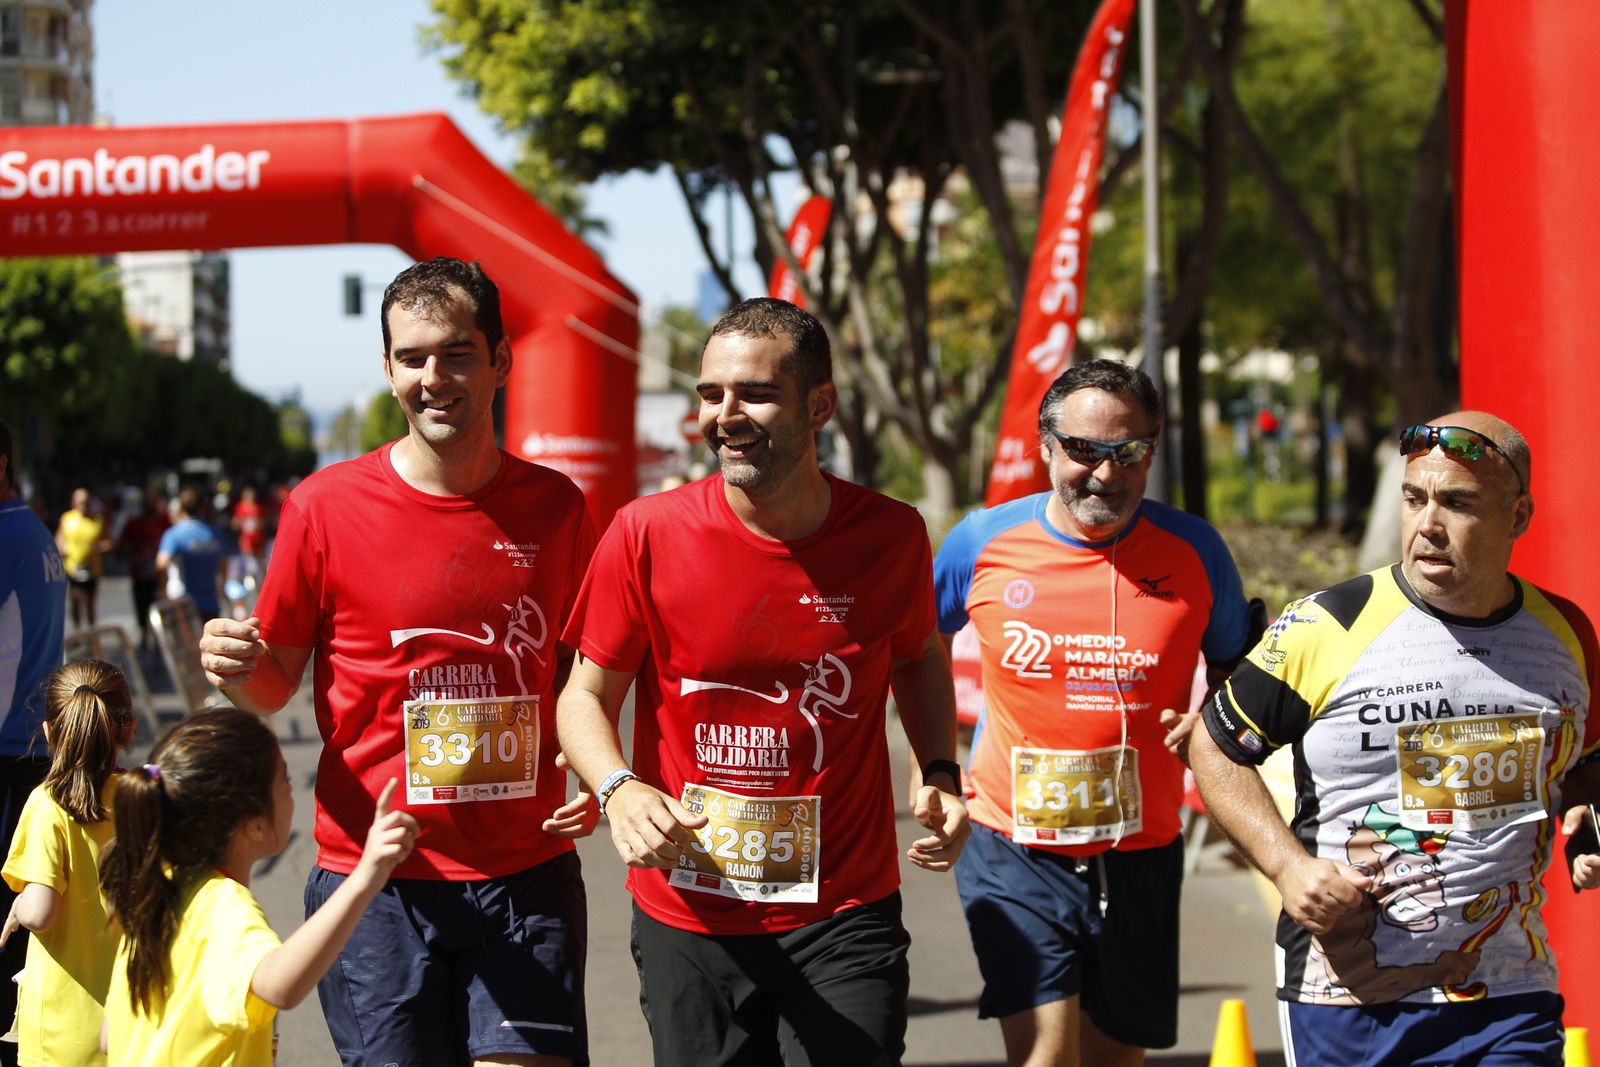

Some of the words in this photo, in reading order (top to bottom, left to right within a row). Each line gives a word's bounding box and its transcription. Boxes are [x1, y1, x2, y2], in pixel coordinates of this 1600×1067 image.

[0, 144, 270, 199] Santander
[504, 542, 540, 550] Santander
[813, 594, 855, 604] Santander
[1065, 634, 1126, 648] MEDIO
[1065, 649, 1159, 666] MARATÓN
[409, 664, 497, 686] CARRERA
[1065, 666, 1147, 682] ALMERÍA
[409, 685, 498, 700] SOLIDARIA
[1358, 690, 1371, 699] IV
[1376, 682, 1444, 697] CARRERA
[437, 705, 450, 726] 6
[457, 704, 503, 715] CARRERA
[458, 712, 504, 723] SOLIDARIA
[1358, 698, 1454, 725] CUNA
[1466, 704, 1488, 715] DE
[1495, 704, 1514, 714] LA
[412, 719, 430, 730] 2019
[694, 723, 790, 748] CARRERA
[1430, 725, 1444, 748] 6
[1452, 722, 1500, 734] CARRERA
[1452, 730, 1502, 744] SOLIDARIA
[420, 730, 519, 766] 3310
[1404, 740, 1424, 751] 2019
[696, 744, 790, 768] SOLIDARIA
[1416, 750, 1520, 788] 3286
[1024, 778, 1114, 810] 3311
[1455, 789, 1496, 806] GABRIEL
[688, 801, 704, 814] 2019
[709, 795, 721, 816] 6
[728, 800, 777, 813] CARRERA
[728, 809, 776, 821] SOLIDARIA
[690, 821, 795, 862] 3285
[726, 861, 764, 878] RAMÓN
